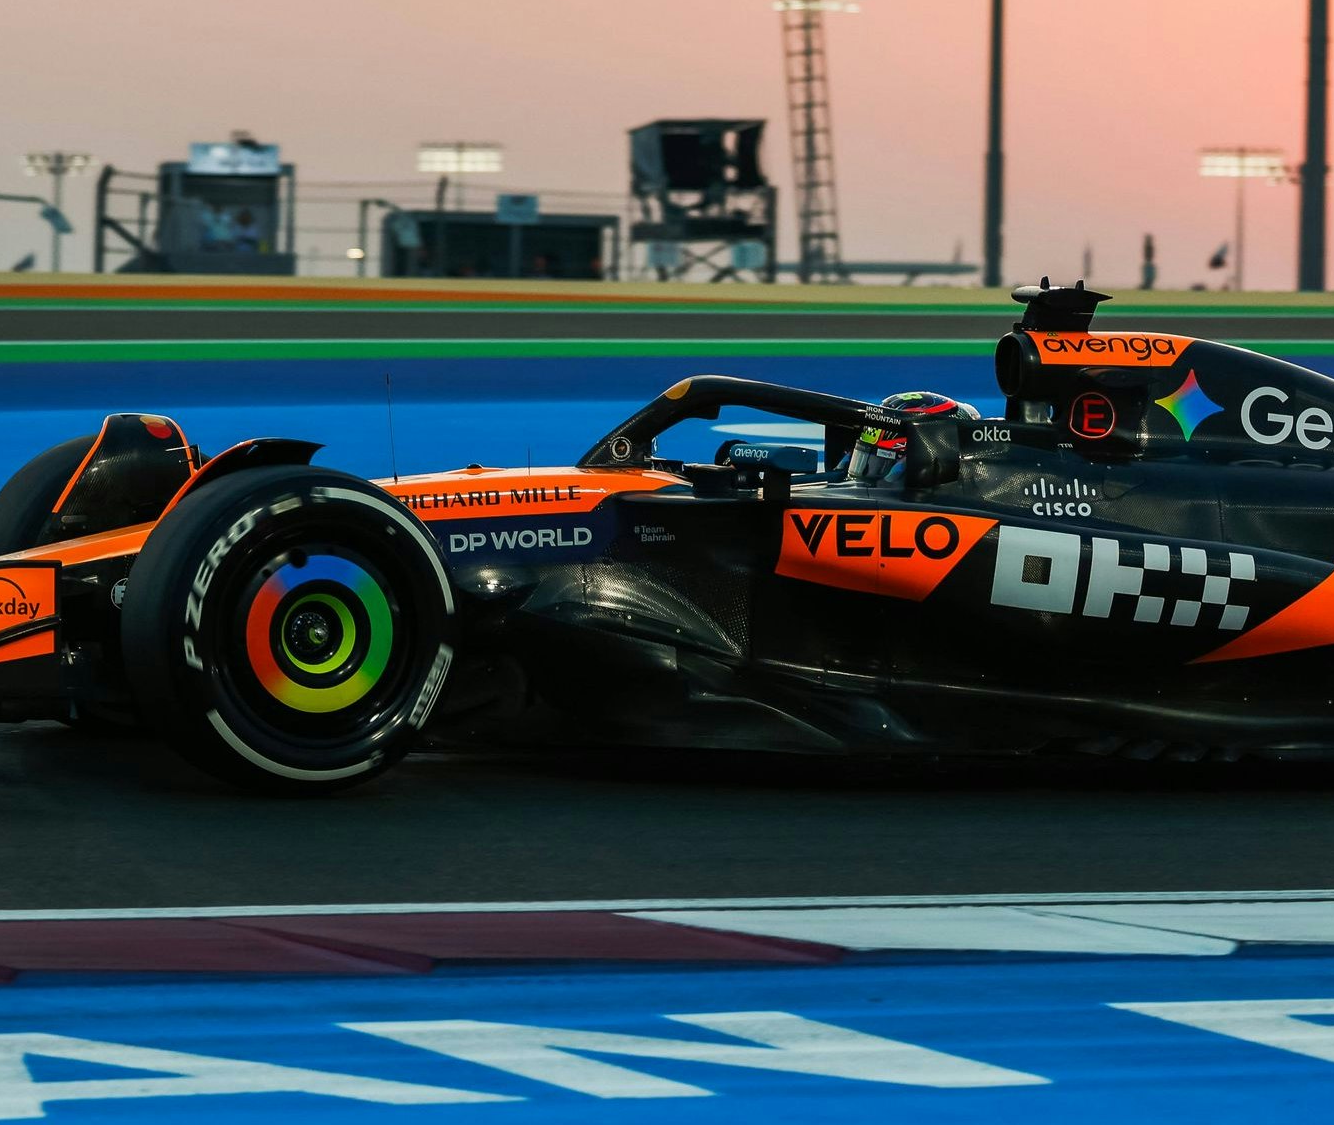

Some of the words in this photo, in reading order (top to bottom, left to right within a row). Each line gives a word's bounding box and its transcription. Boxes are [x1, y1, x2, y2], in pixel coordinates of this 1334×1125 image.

[1043, 337, 1176, 361] avenga
[865, 413, 902, 426] MOUNTAIN
[866, 405, 884, 414] IRON
[972, 426, 1012, 442] okta
[734, 447, 769, 462] avenga
[510, 485, 582, 504] MILLE
[449, 532, 487, 553] DP
[491, 527, 593, 551] WORLD
[641, 533, 676, 542] Bahrain
[790, 513, 960, 560] VELO
[185, 511, 259, 631] ZERO
[990, 524, 1257, 631] OKX
[183, 636, 204, 672] P
